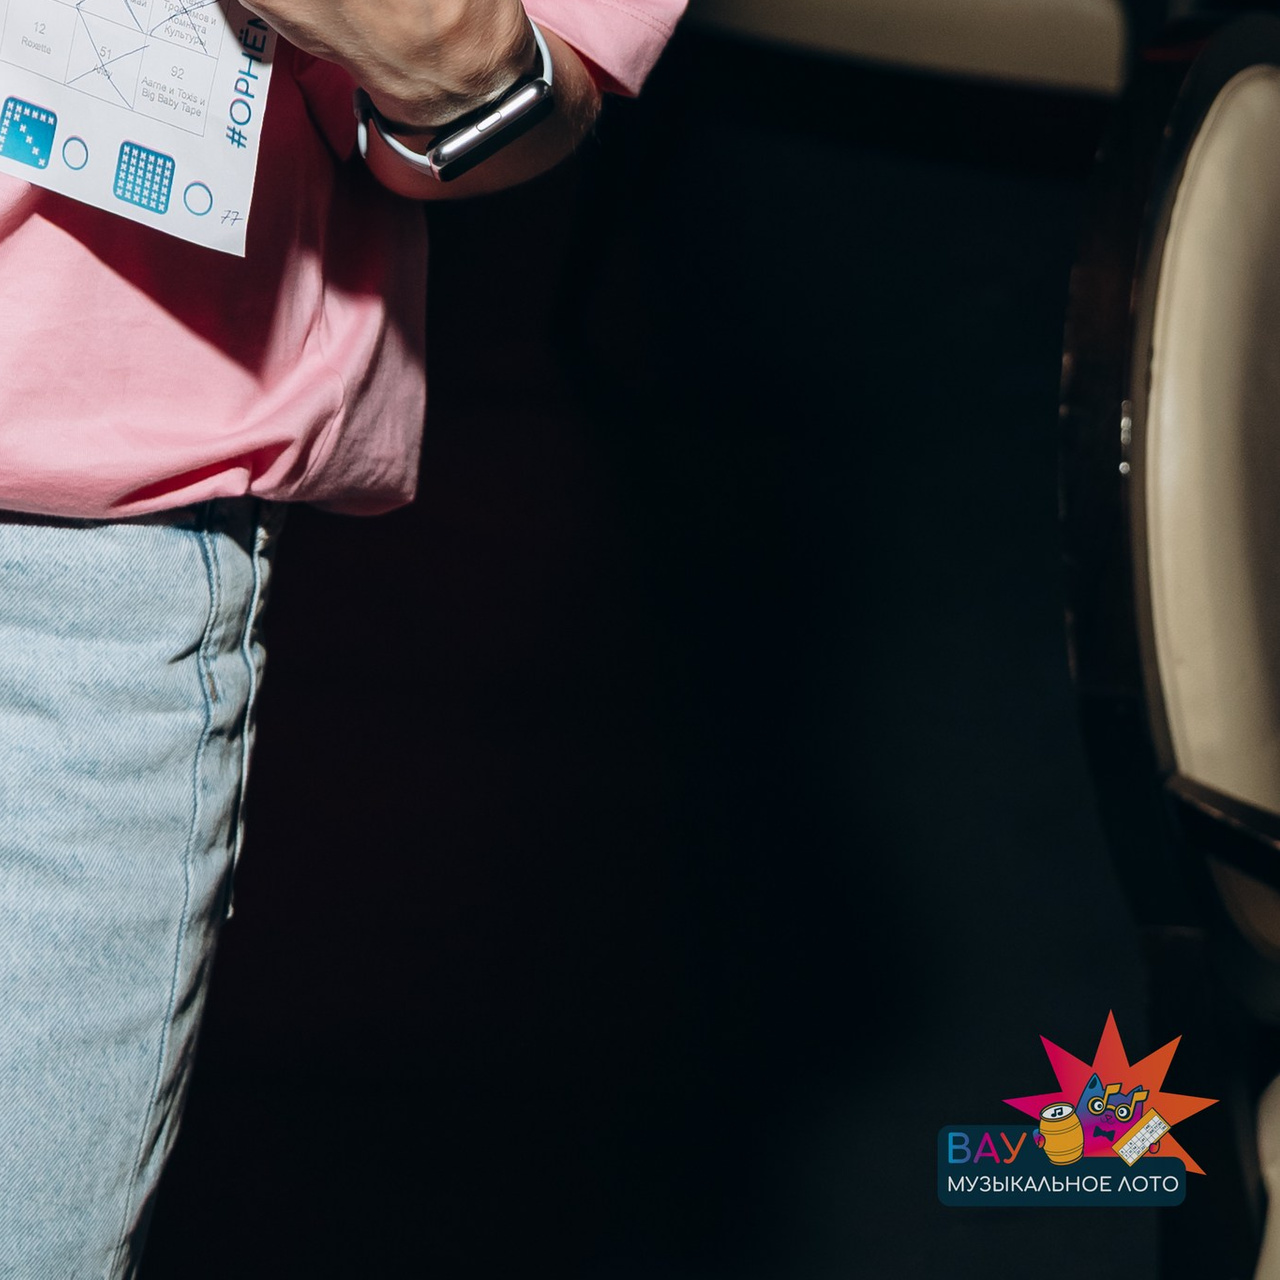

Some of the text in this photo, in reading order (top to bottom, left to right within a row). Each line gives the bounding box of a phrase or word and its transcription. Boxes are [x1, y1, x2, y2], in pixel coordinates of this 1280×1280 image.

[33, 21, 46, 35] 12
[21, 35, 52, 55] Roxette
[99, 45, 112, 60] 51
[170, 65, 185, 80] 92
[141, 75, 168, 92] Aarne
[177, 88, 198, 103] Toxis
[141, 87, 202, 118] Big Baby Tape
[220, 210, 244, 226] 77
